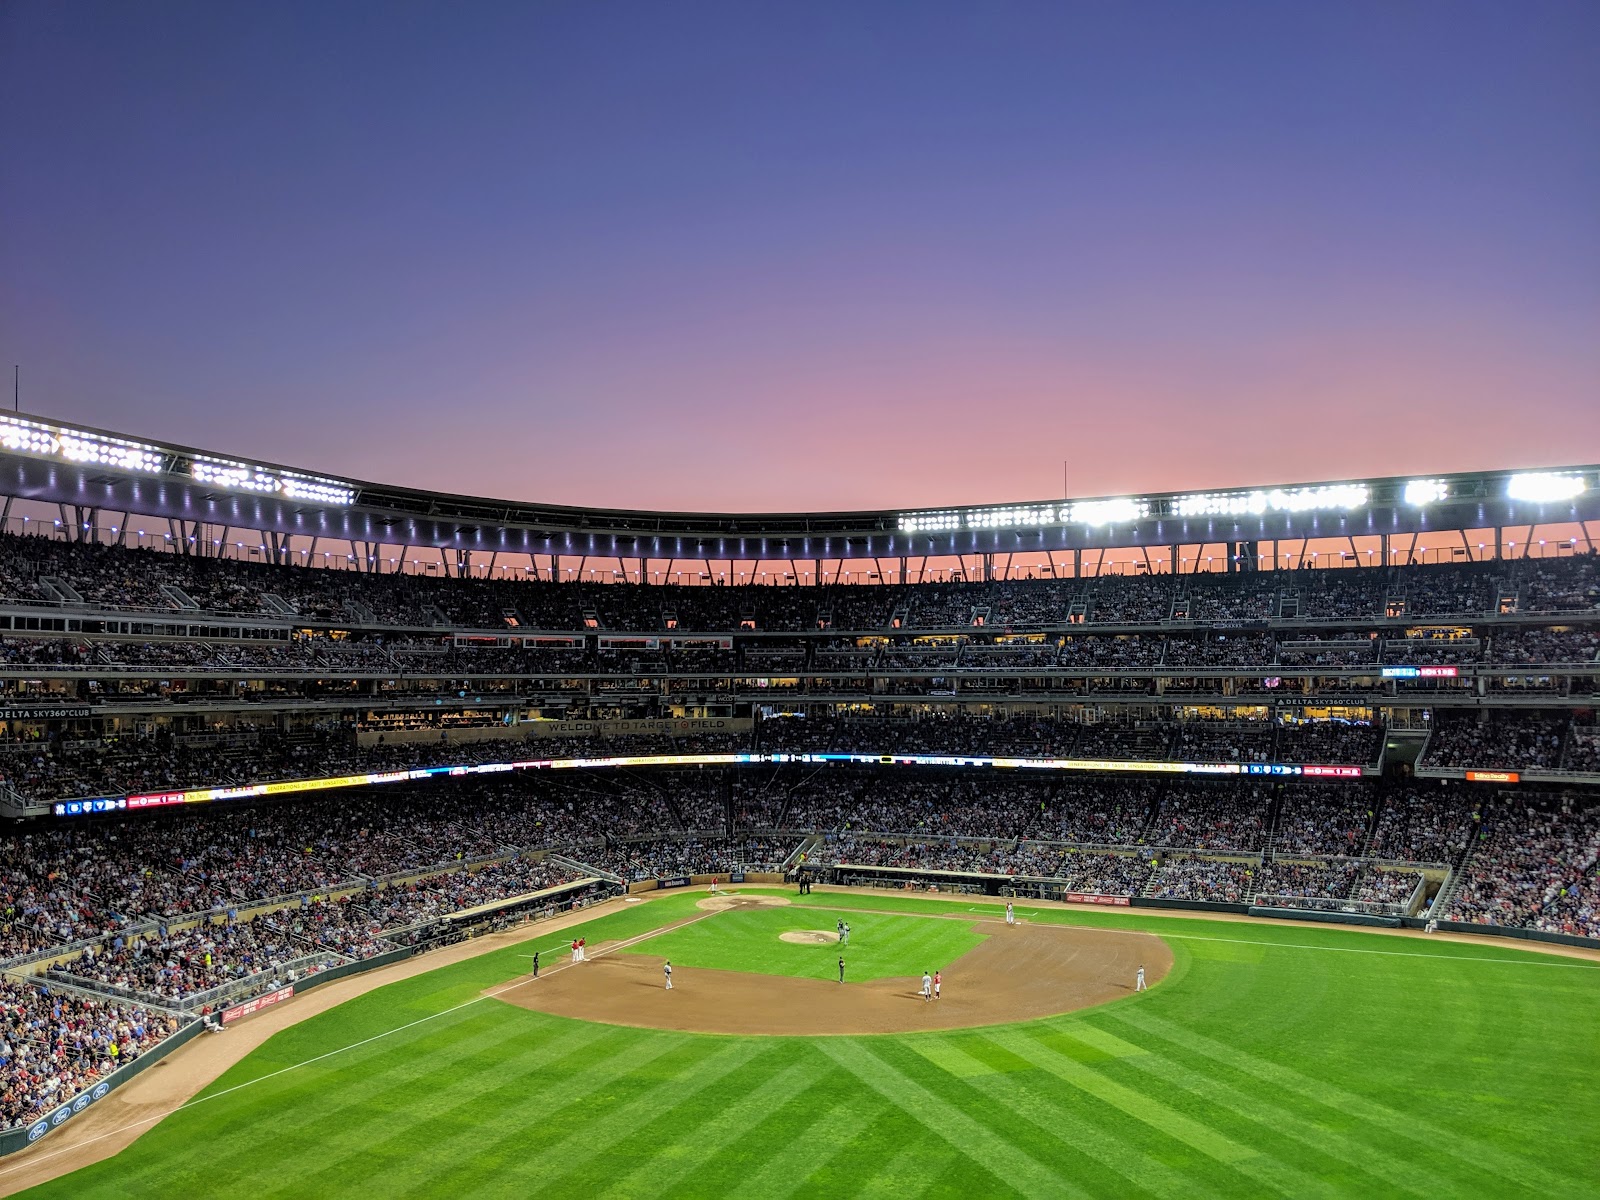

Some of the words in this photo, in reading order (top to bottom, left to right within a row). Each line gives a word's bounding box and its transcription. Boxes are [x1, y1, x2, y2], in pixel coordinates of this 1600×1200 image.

[69, 709, 89, 717] CLUB
[549, 722, 611, 732] WELCOME
[613, 722, 630, 730] TO
[633, 720, 679, 730] TARGET
[691, 720, 725, 728] FIELD
